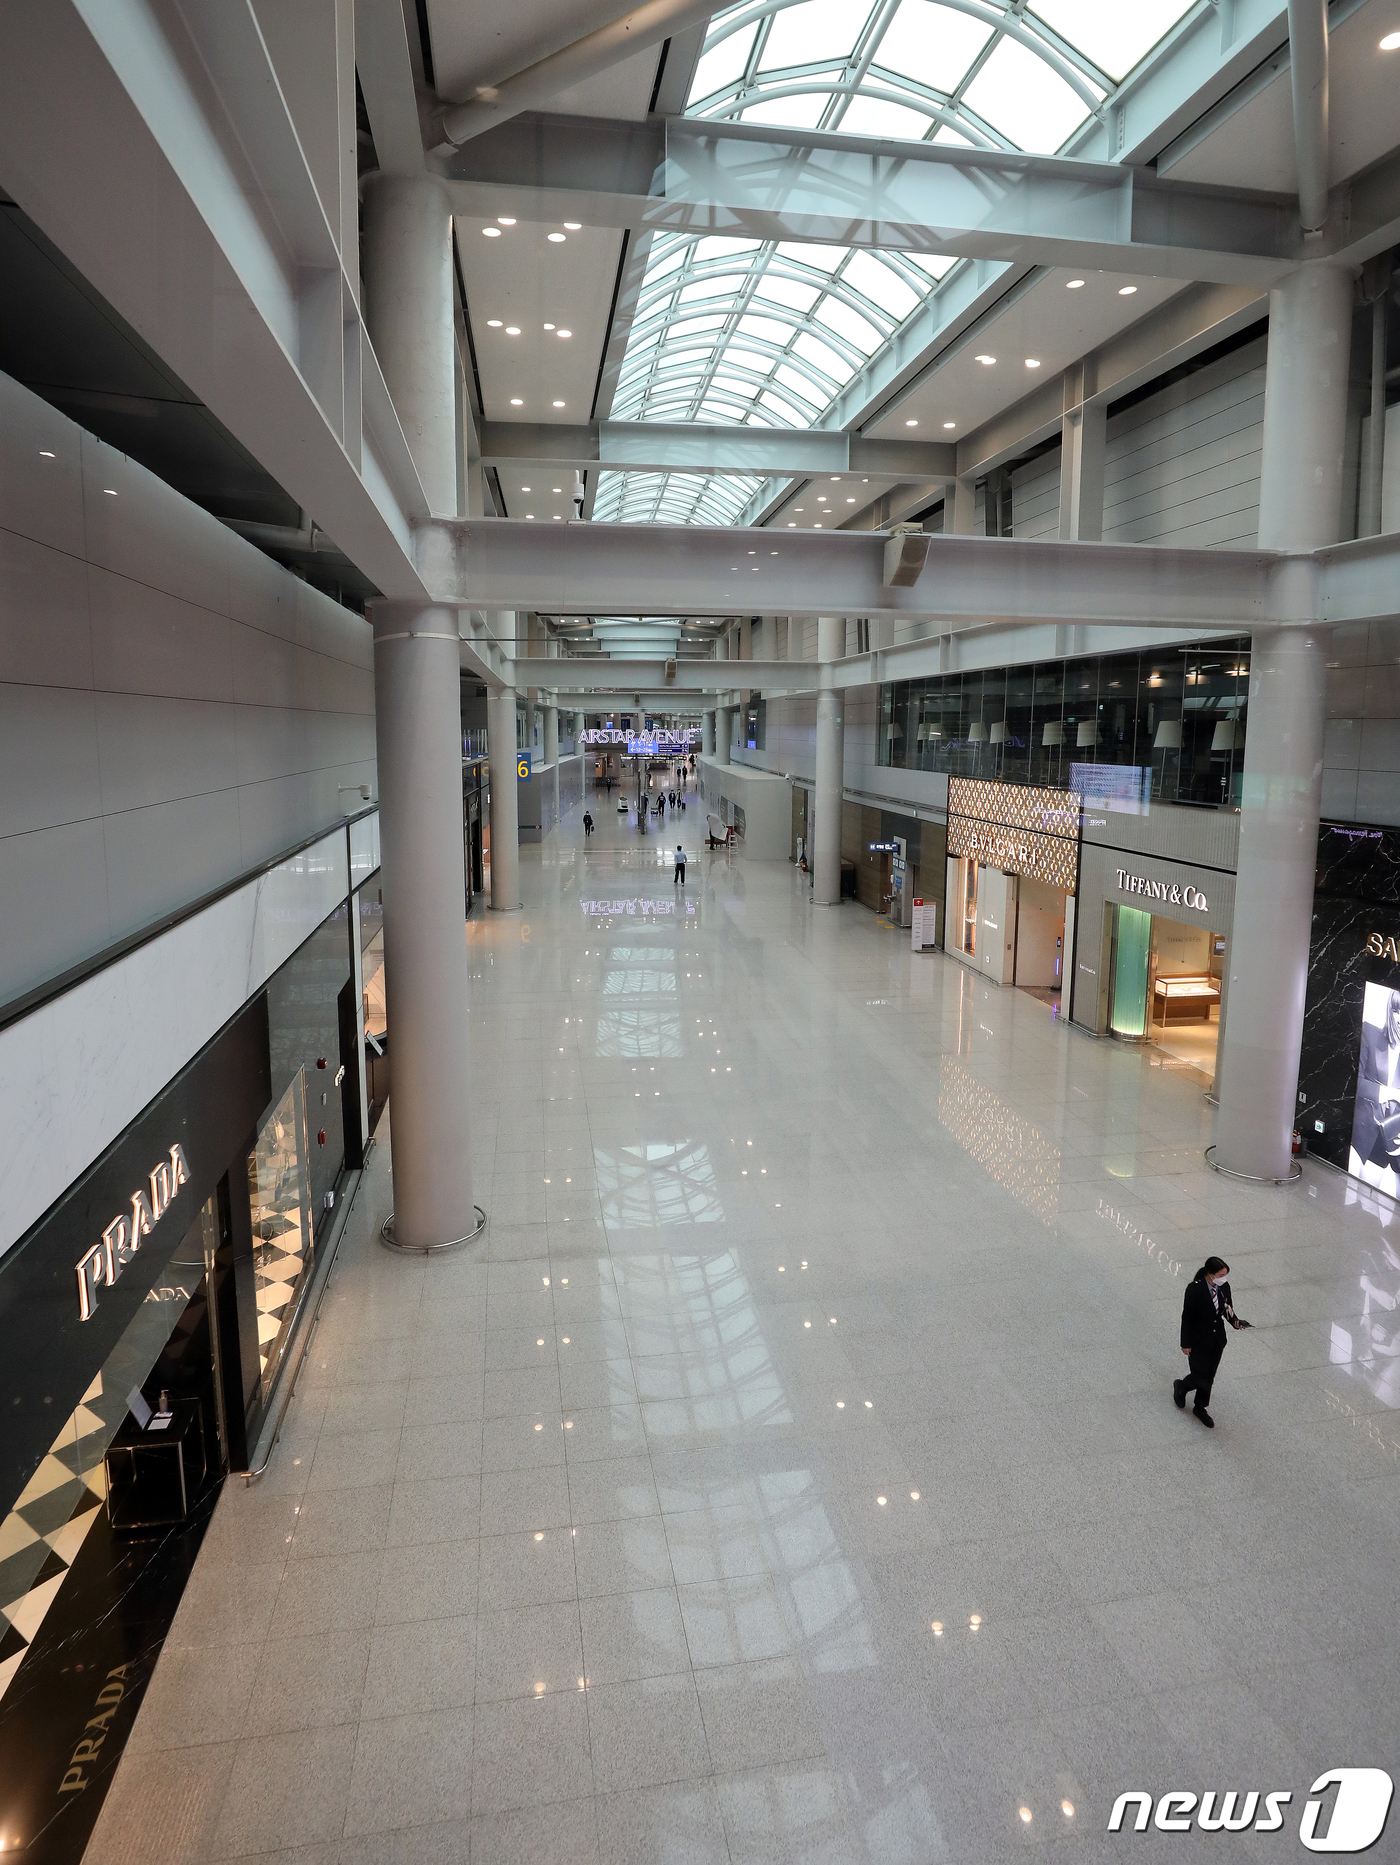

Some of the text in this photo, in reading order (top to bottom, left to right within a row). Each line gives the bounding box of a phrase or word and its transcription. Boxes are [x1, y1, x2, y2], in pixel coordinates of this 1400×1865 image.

[578, 729, 696, 744] AIRSTAR AVENUE
[517, 760, 529, 778] 6
[971, 832, 1038, 865] BVLGARI
[1366, 932, 1400, 963] SA
[75, 1143, 191, 1321] PRADA
[58, 1660, 136, 1795] PRADA
